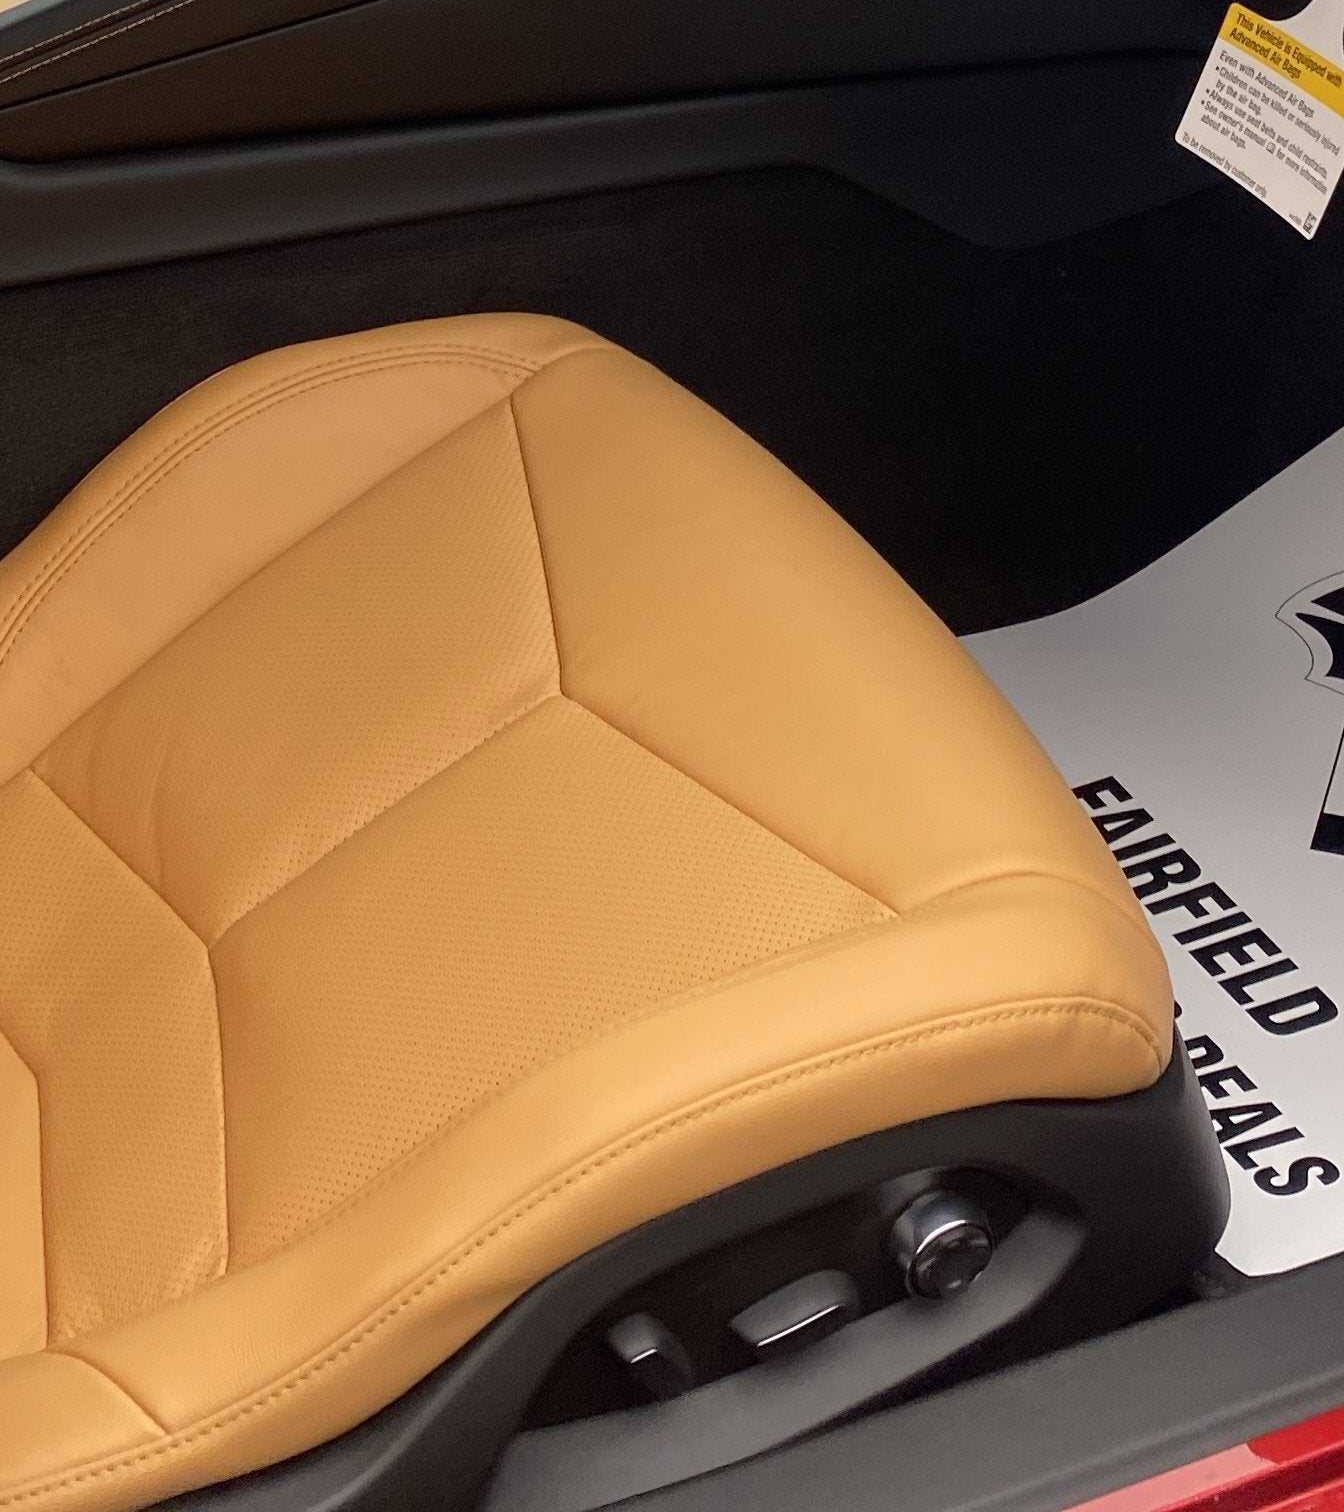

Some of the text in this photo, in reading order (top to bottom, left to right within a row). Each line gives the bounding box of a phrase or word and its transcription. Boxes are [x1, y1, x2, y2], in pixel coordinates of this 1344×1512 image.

[1229, 27, 1302, 79] Advanced Air Bags
[1236, 12, 1254, 32] This
[1255, 24, 1284, 49] Vehicle
[1283, 42, 1292, 55] is
[1292, 46, 1327, 77] Equipped
[1216, 79, 1226, 92] by
[1226, 86, 1238, 99] the
[1238, 94, 1248, 104] air
[1219, 50, 1315, 118] Even with Advanced Air Bags
[1219, 67, 1248, 90] Children
[1248, 86, 1261, 98] can
[1261, 93, 1270, 105] be
[1270, 99, 1288, 117] killed
[1287, 113, 1295, 121] or
[1201, 114, 1221, 132] about
[1220, 127, 1230, 136] air
[1204, 101, 1218, 115] See
[1218, 111, 1244, 132] owner's
[1243, 127, 1267, 147] manual
[1276, 148, 1285, 161] for
[1285, 157, 1300, 172] more
[1209, 90, 1234, 110] Always
[1247, 115, 1262, 128] seat
[1261, 122, 1276, 139] belts
[1276, 135, 1289, 148] and
[1182, 131, 1190, 143] To
[1190, 137, 1199, 149] be
[1198, 144, 1226, 166] removed
[1224, 160, 1232, 171] by
[1072, 775, 1339, 1037] FAIRFIELD
